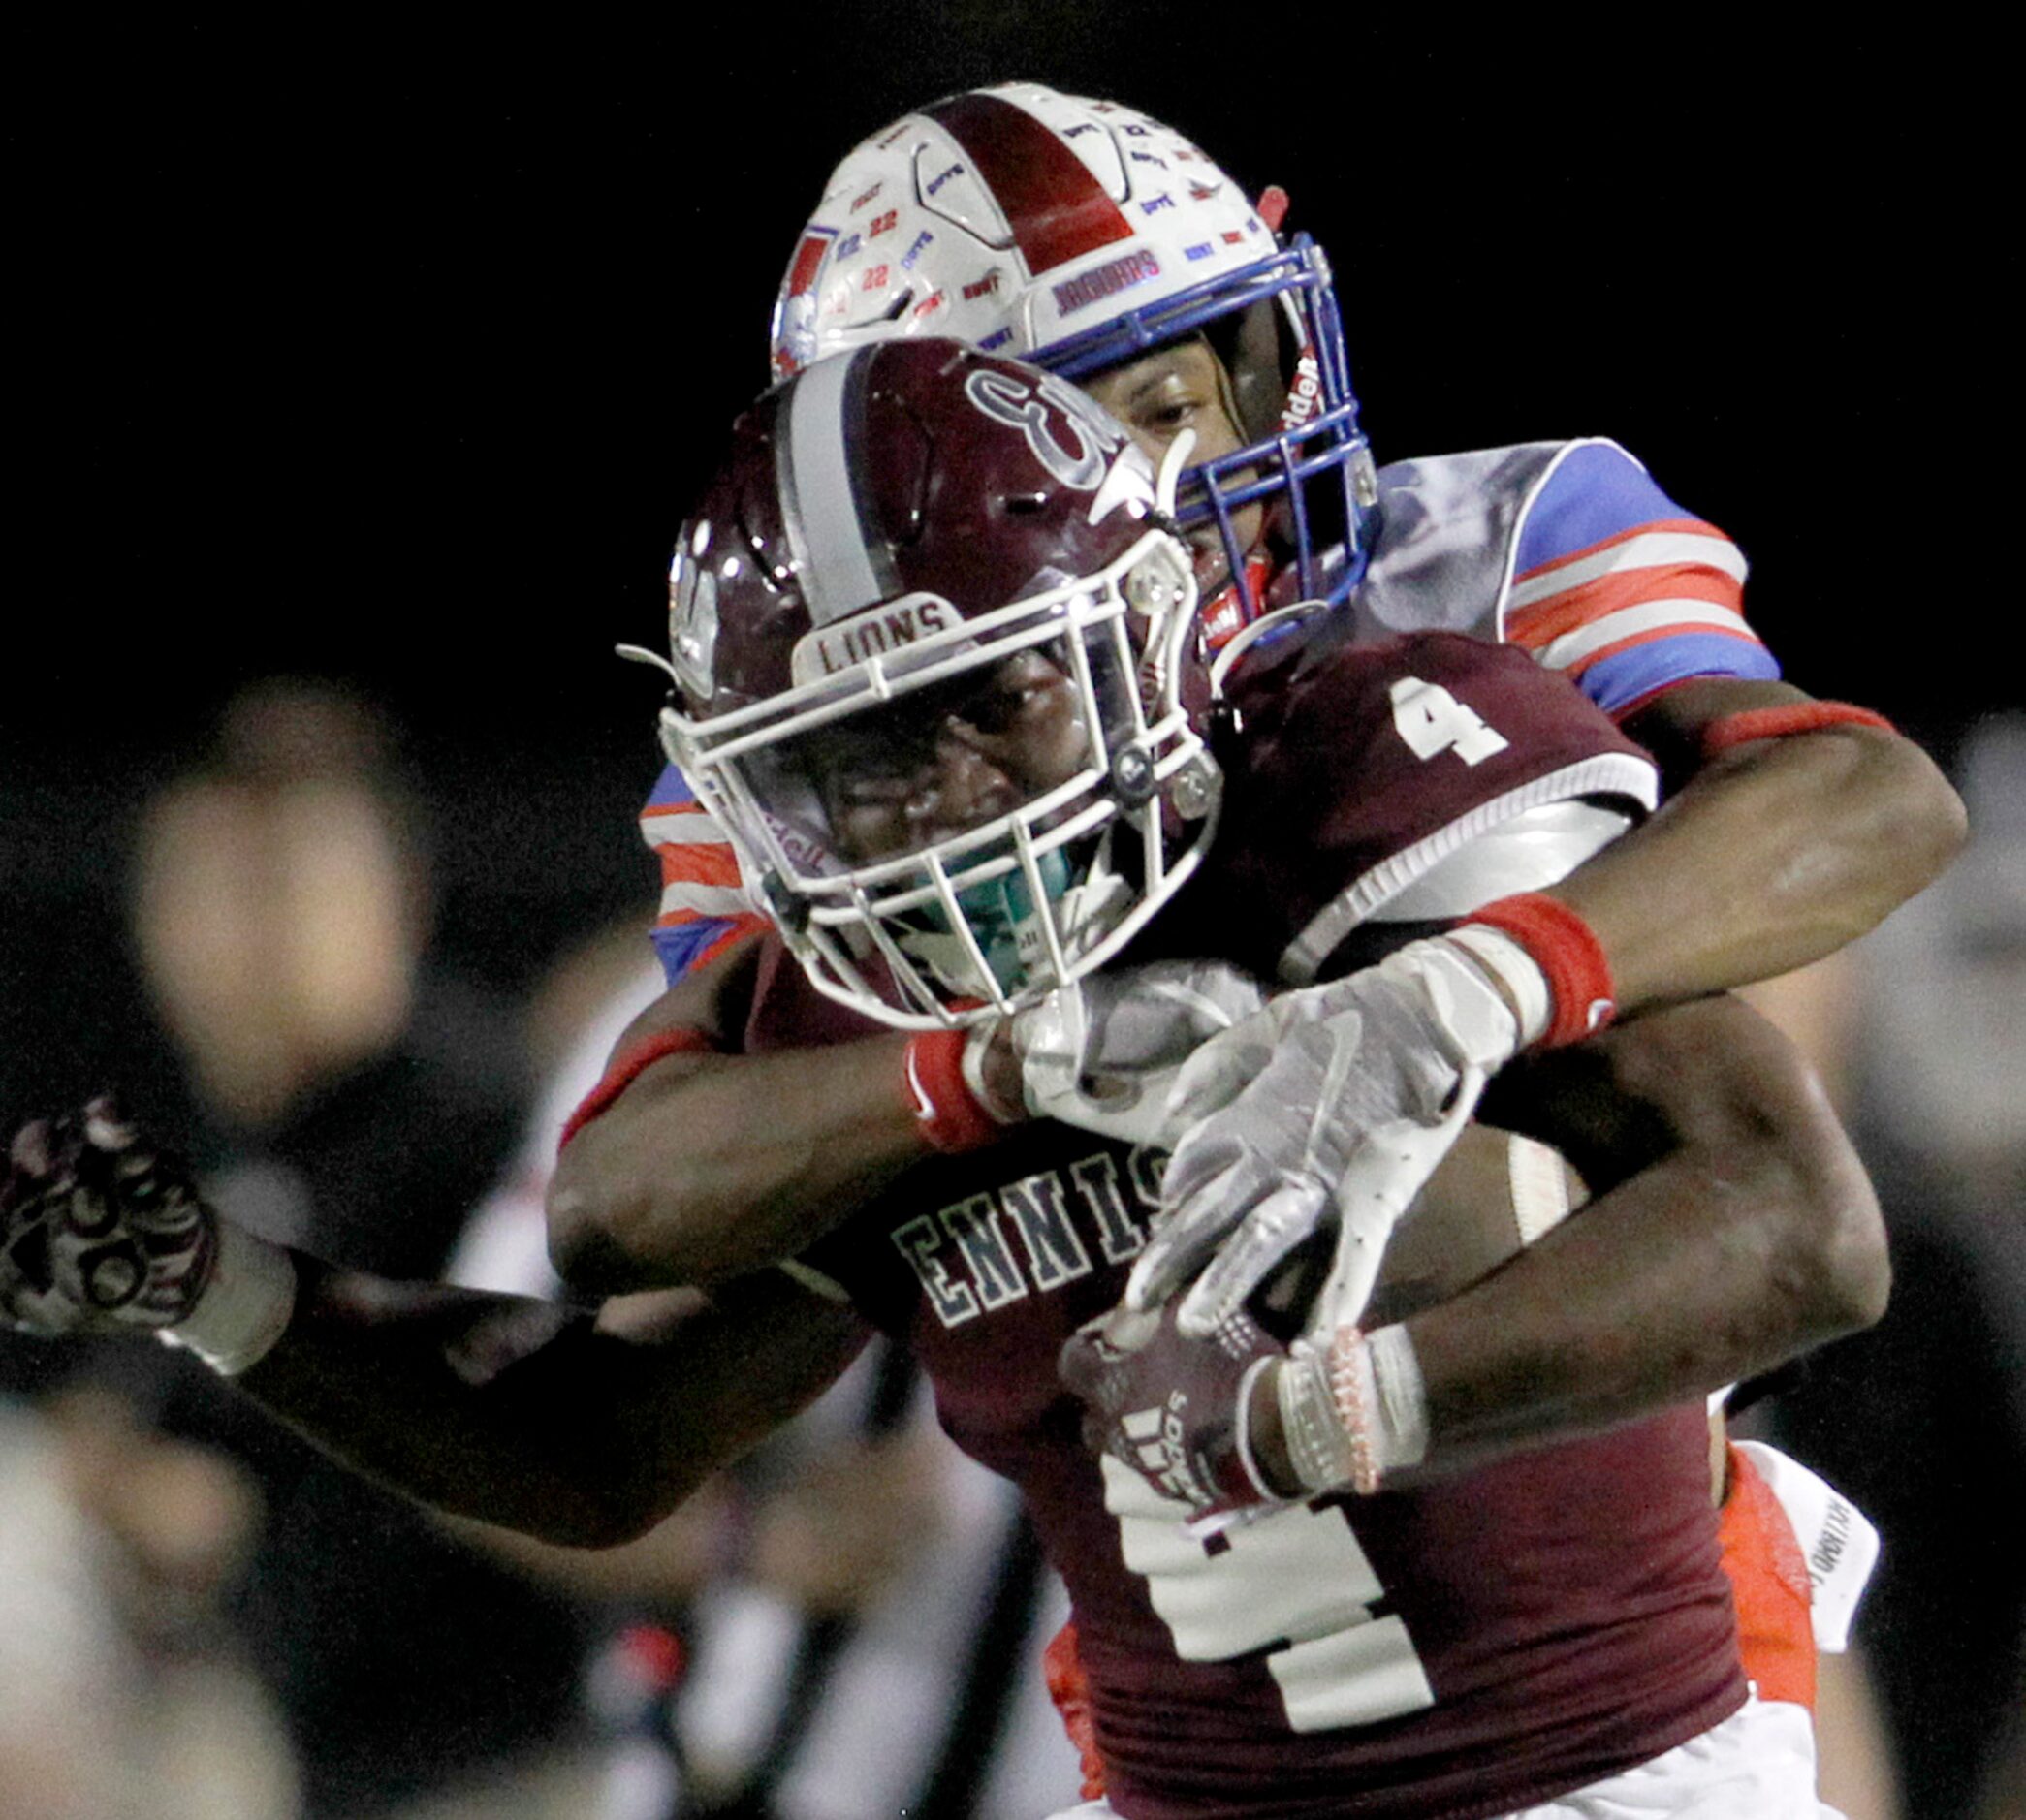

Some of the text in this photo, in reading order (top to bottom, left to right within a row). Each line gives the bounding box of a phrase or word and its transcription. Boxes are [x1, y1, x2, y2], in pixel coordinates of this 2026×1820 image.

[870, 209, 898, 238] 22
[862, 264, 889, 291] 22
[817, 601, 945, 674] LIONS
[1390, 675, 1509, 767] 4
[1099, 1452, 1436, 1734] 4
